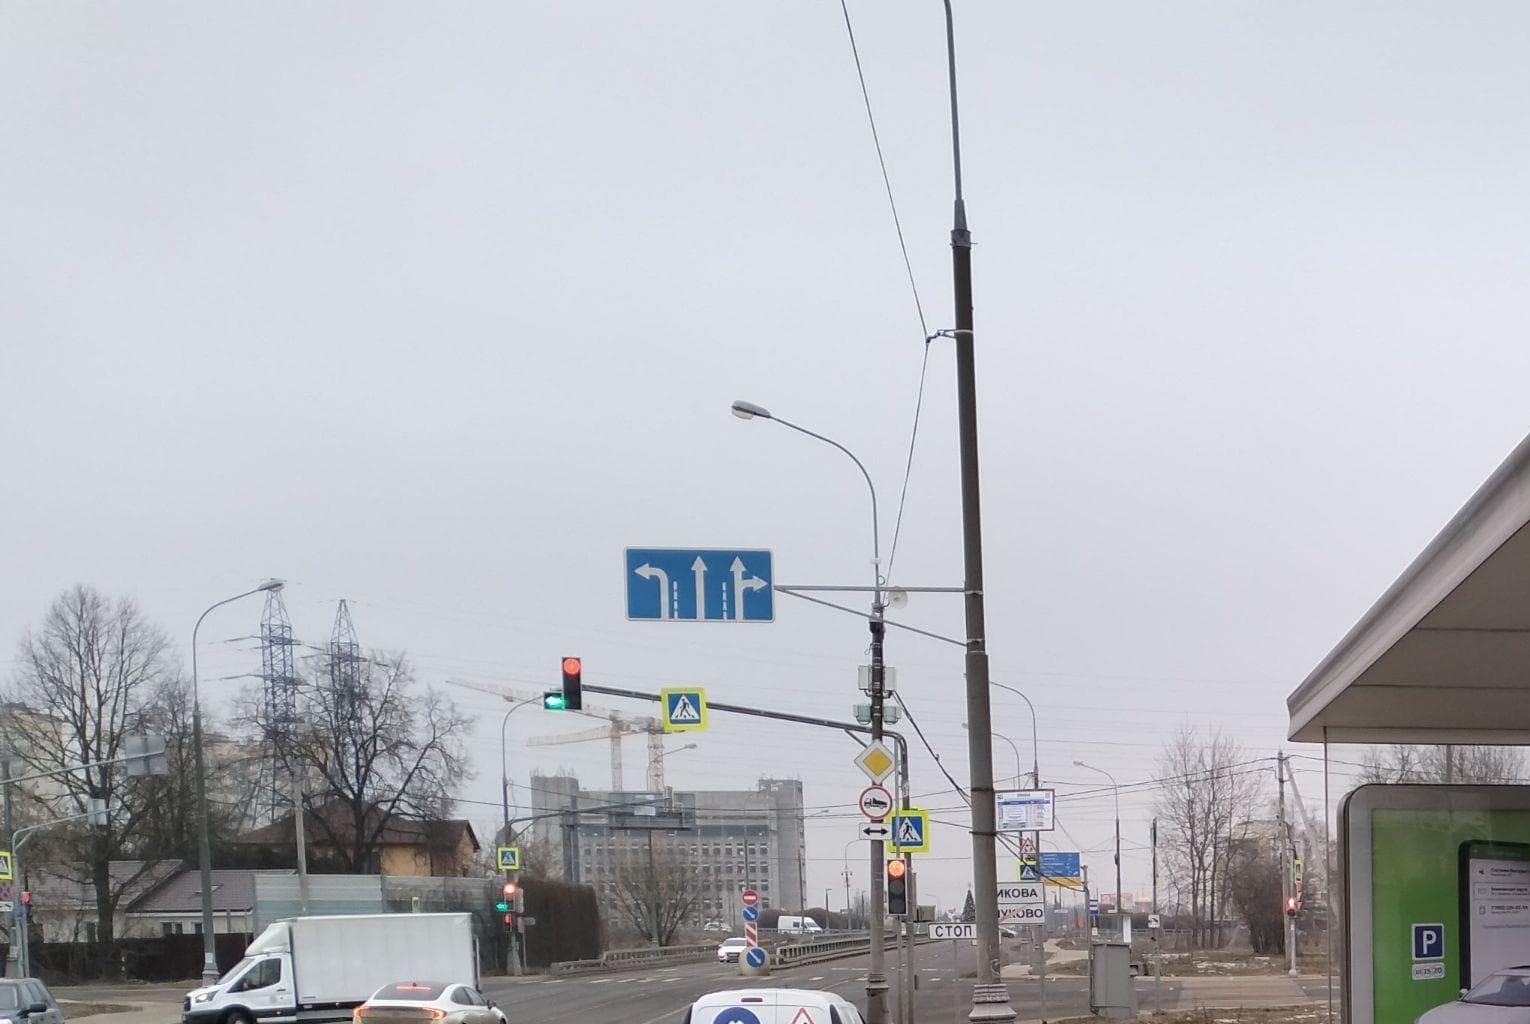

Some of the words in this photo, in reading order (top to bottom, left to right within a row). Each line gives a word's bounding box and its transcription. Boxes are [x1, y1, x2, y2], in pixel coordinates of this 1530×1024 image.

[997, 888, 1038, 898] ИКОВА
[935, 925, 972, 938] СТОП
[1423, 930, 1437, 955] P
